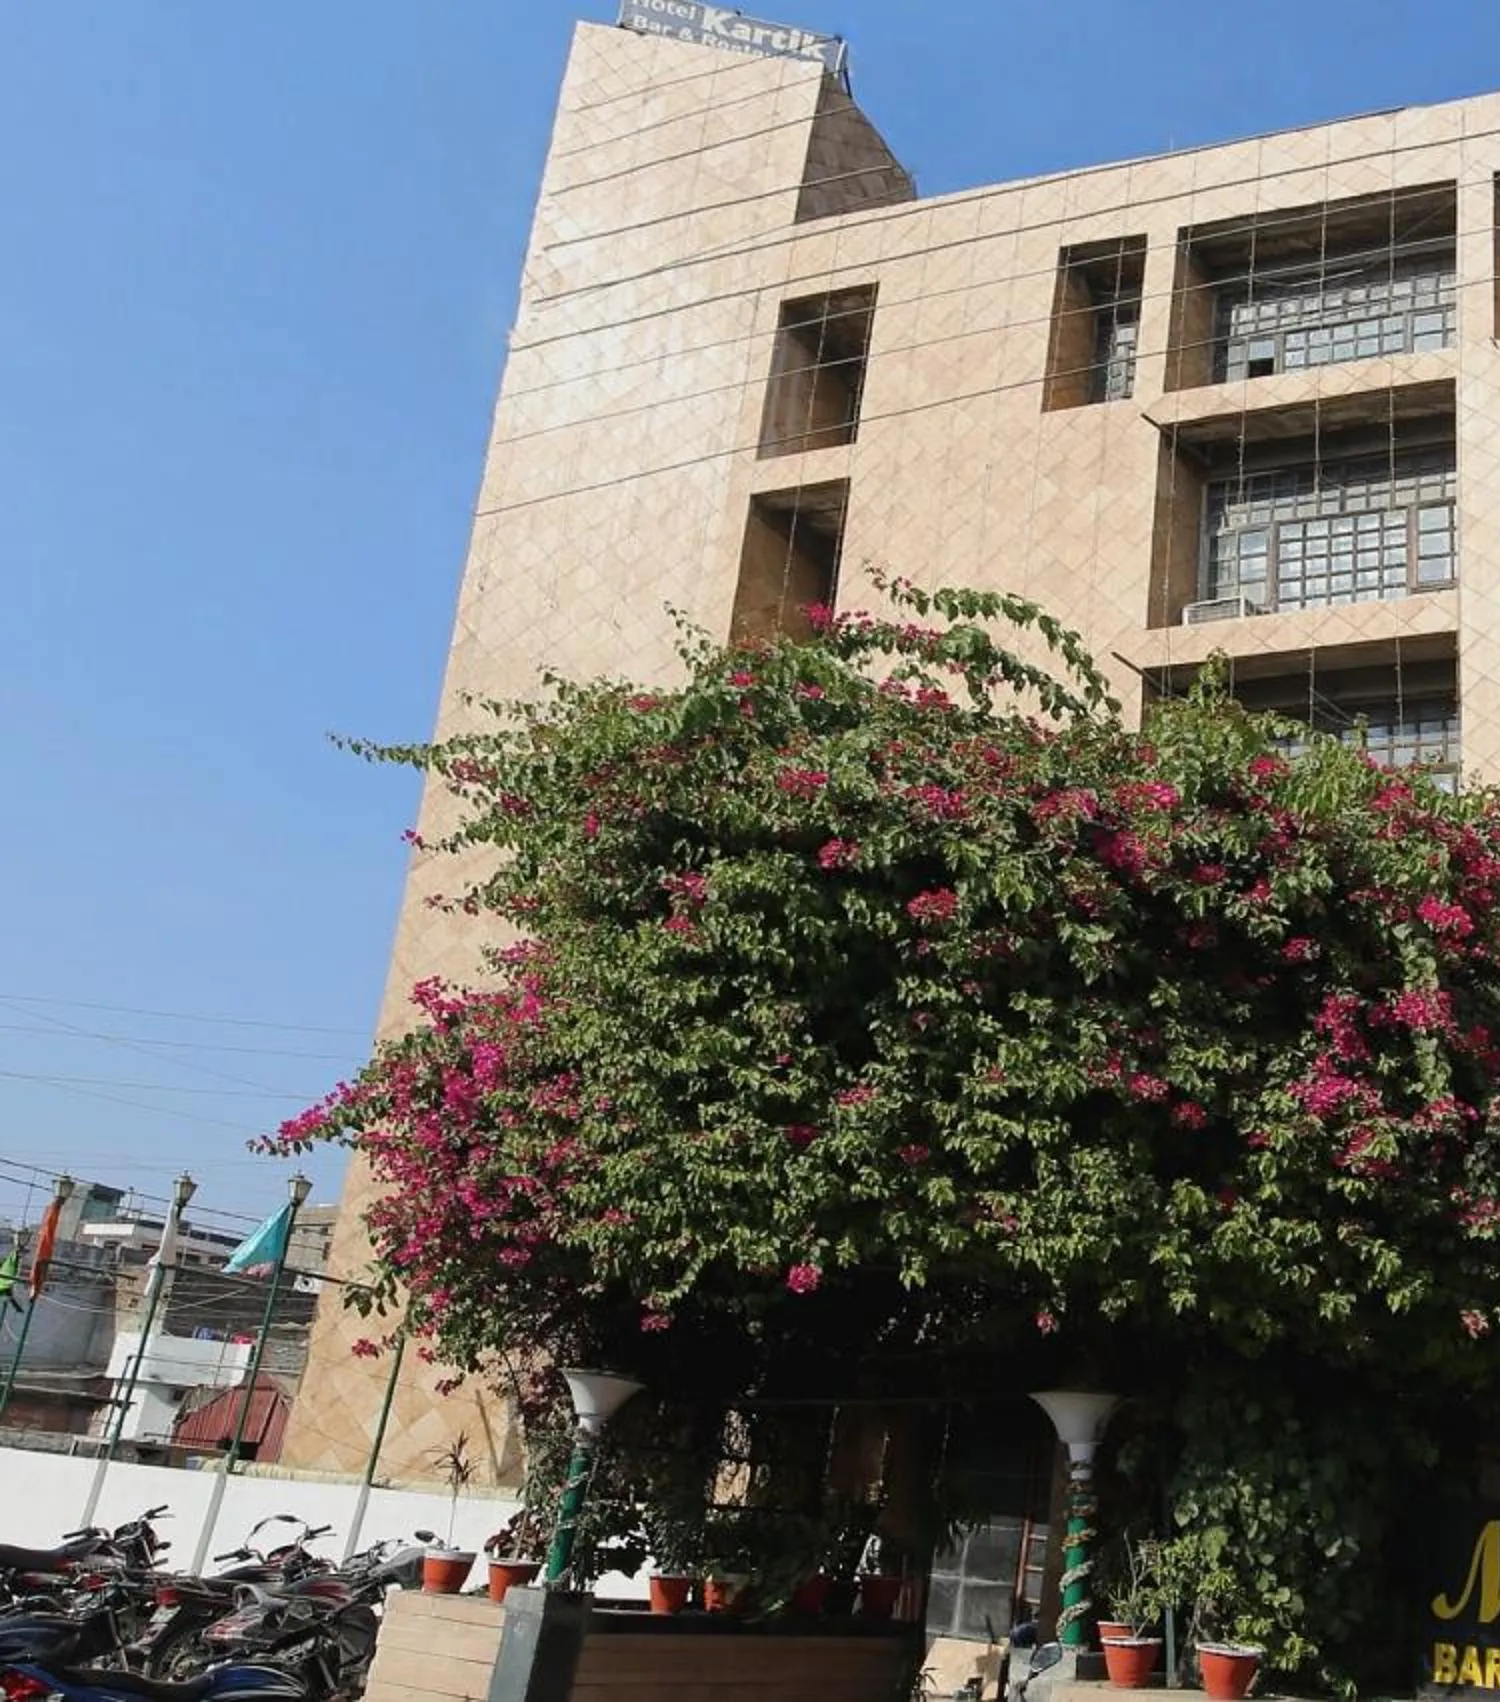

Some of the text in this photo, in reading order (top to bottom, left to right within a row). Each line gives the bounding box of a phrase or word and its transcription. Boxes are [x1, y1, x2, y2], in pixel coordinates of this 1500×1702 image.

[633, 14, 673, 36] Bar
[679, 26, 694, 41] &
[701, 7, 827, 59] Kartik
